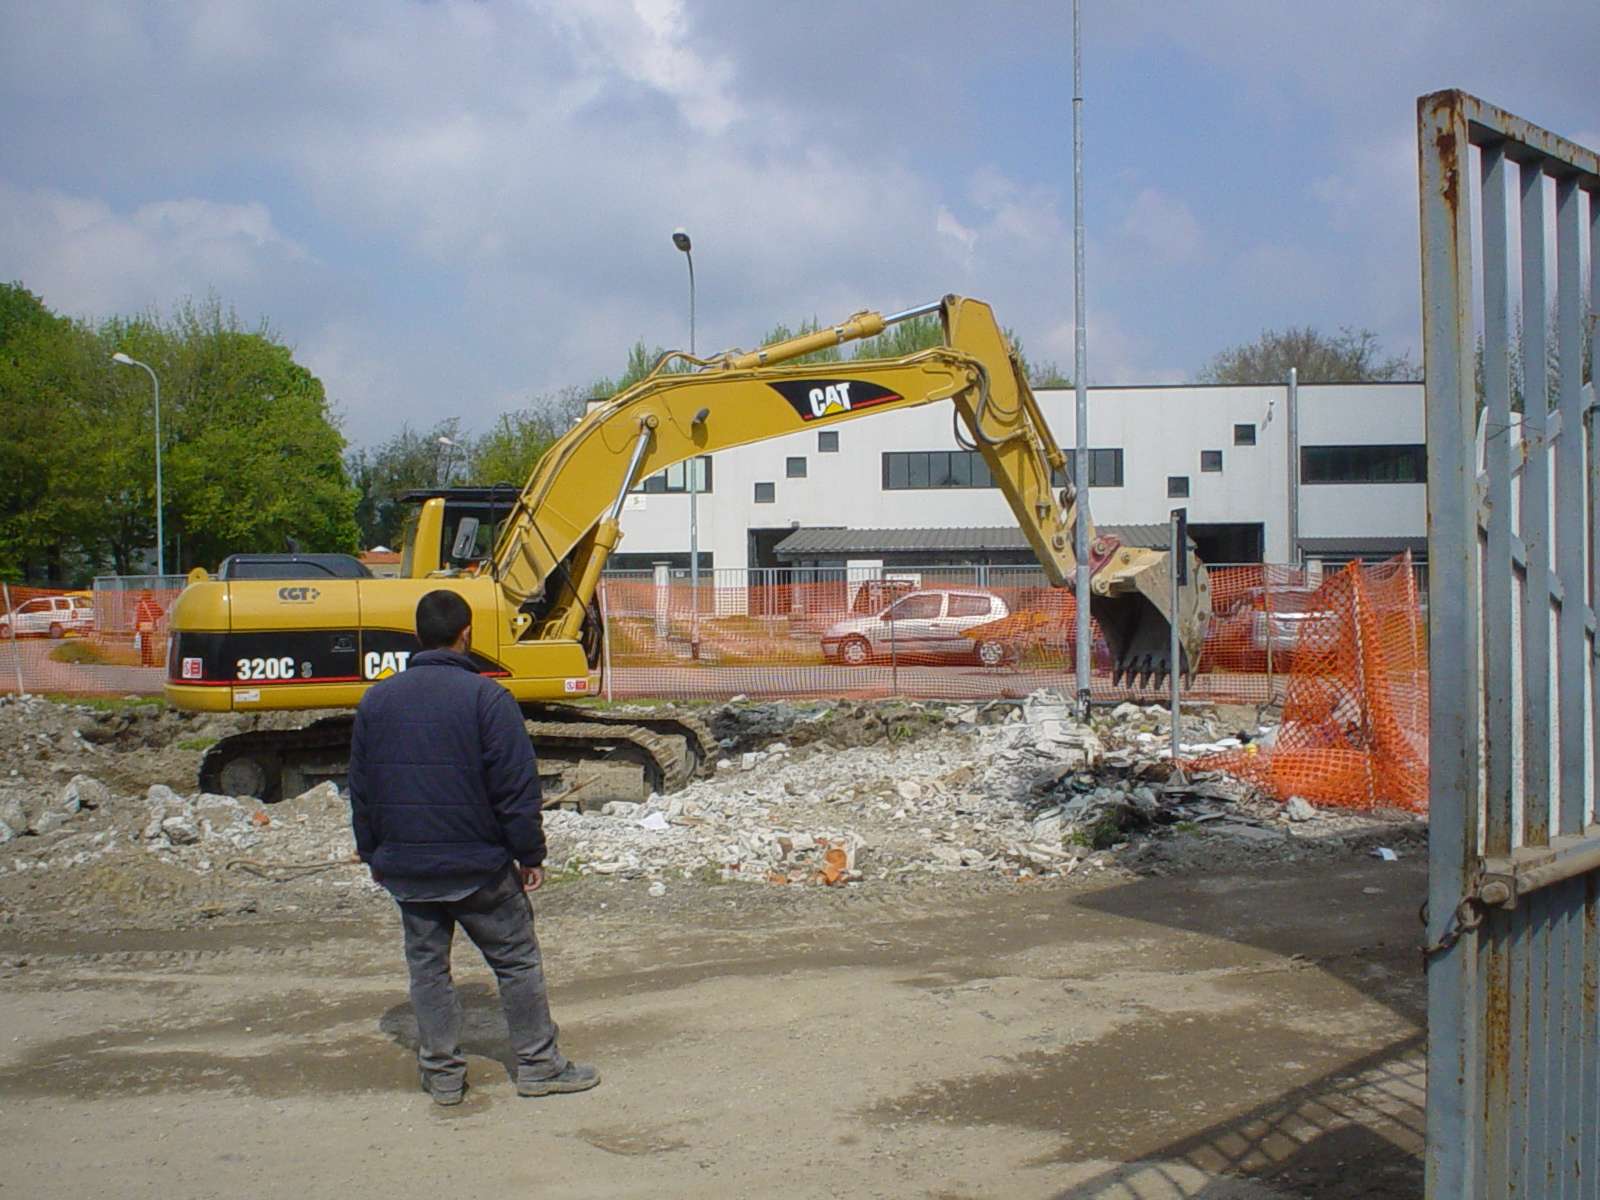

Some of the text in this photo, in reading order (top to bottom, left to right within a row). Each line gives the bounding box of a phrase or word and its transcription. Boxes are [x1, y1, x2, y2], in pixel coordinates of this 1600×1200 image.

[808, 382, 851, 417] CAT
[278, 587, 310, 601] CGT
[236, 657, 295, 680] 320C
[364, 651, 411, 680] CAT
